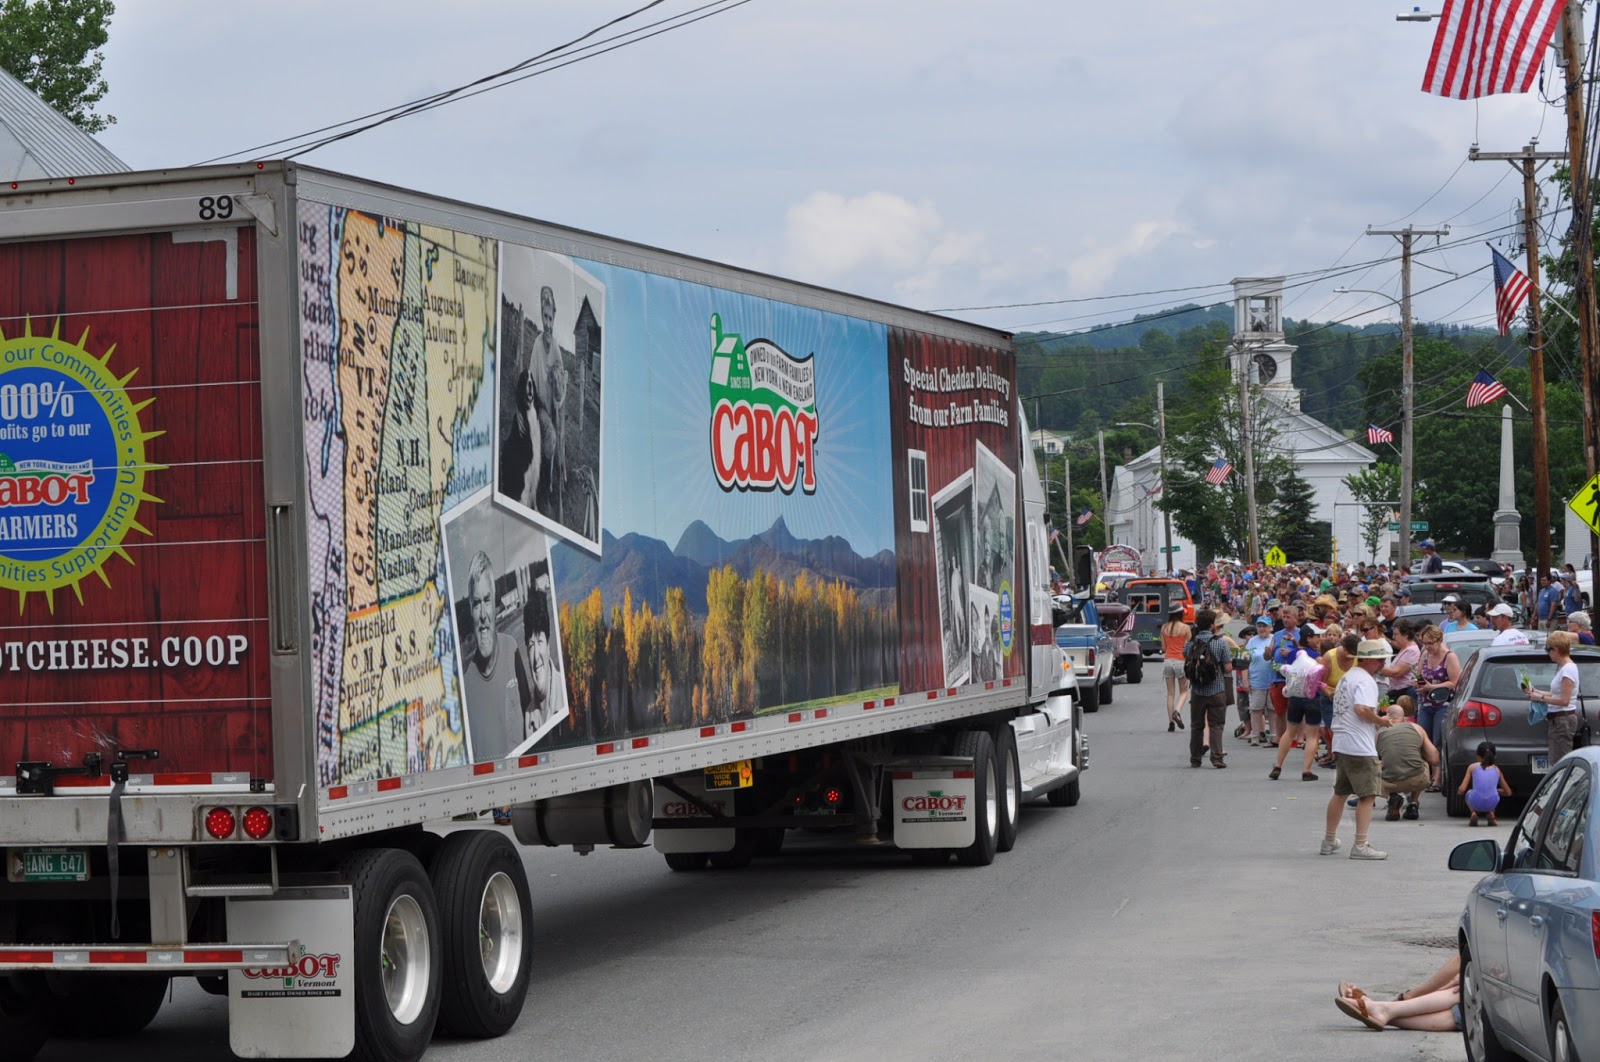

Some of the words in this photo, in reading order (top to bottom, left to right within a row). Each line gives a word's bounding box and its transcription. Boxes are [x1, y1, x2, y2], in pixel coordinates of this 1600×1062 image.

[199, 194, 233, 220] 89
[455, 259, 486, 292] Bangor
[367, 285, 424, 324] Montpelier
[424, 285, 463, 318] Augusta
[426, 318, 458, 345] Auburn
[754, 366, 765, 384] NEW
[903, 357, 938, 392] Special
[940, 366, 975, 393] Cheddar
[976, 365, 1010, 401] Delivery
[0, 381, 74, 420] 00%
[4, 347, 35, 363] our
[41, 344, 132, 441] Communities
[909, 395, 932, 426] from
[933, 408, 949, 427] our
[950, 402, 973, 426] Farm
[973, 398, 1008, 428] Families
[32, 425, 47, 442] go
[51, 423, 65, 437] to
[69, 424, 91, 436] our
[455, 424, 489, 452] Portland
[364, 467, 408, 496] Rutland
[409, 482, 445, 513] Concord
[0, 513, 78, 540] ARMERS
[51, 491, 135, 579] Supporting
[120, 460, 136, 484] Us
[378, 523, 435, 554] Manchester
[378, 555, 417, 583] Nashua
[345, 609, 396, 648] Pittsfield
[0, 635, 248, 671] TCHEESE.COOP
[391, 655, 440, 690] Worcester
[319, 740, 371, 788] Hartford
[31, 855, 53, 873] ANG
[60, 854, 82, 873] 647
[298, 979, 336, 988] Vermont
